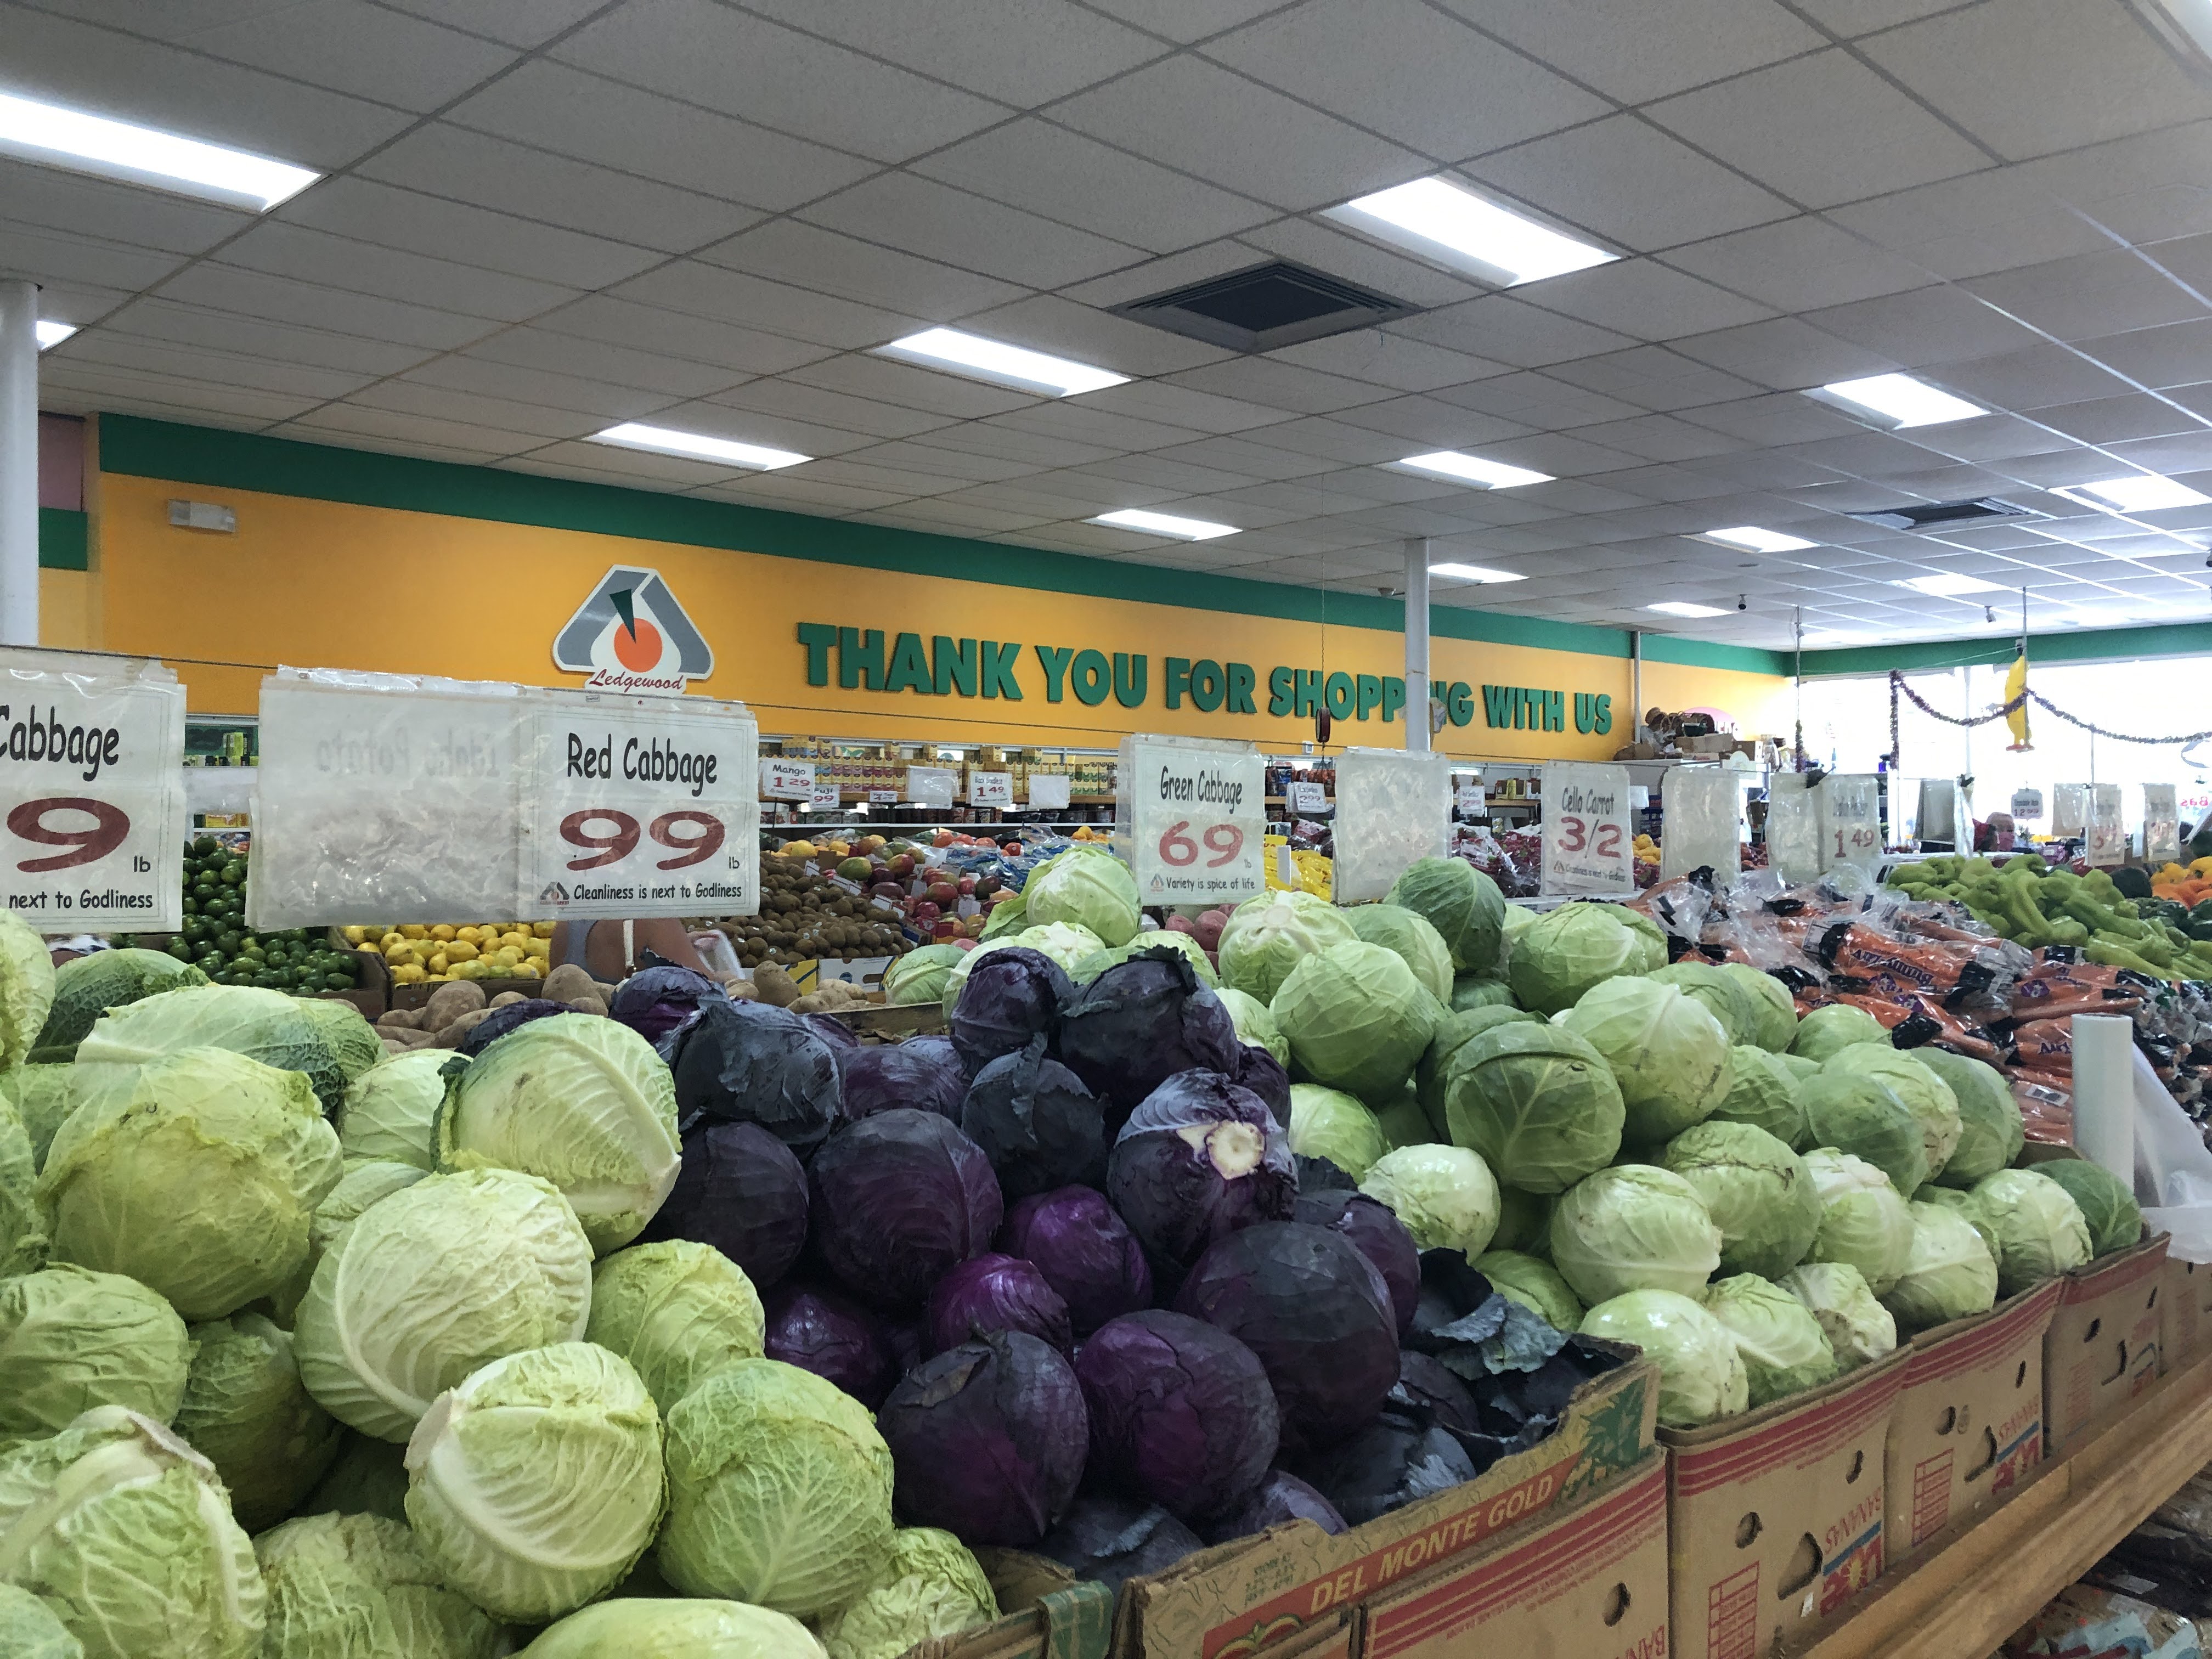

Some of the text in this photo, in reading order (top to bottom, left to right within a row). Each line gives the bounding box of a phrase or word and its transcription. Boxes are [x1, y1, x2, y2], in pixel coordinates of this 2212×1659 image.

[589, 668, 684, 693] Ledgewood
[797, 622, 1612, 735] THANK YOU FOR SHOPPG WITH US
[567, 732, 718, 797] Red Cabbage
[772, 764, 806, 777] Mango
[1160, 765, 1243, 815] Green Cabbage
[1561, 786, 1615, 816] Cello Carrot
[7, 797, 131, 873] 9
[560, 809, 725, 871] 99
[1159, 821, 1244, 868] 69
[1558, 816, 1623, 859] 3/2
[133, 855, 151, 873] lb
[729, 856, 740, 870] lb
[1244, 859, 1252, 868] lb
[9, 889, 153, 909] next to Godliness
[574, 882, 742, 900] Cleanliness is next to Godliness
[1166, 877, 1255, 893] Variety is spice of life
[1309, 1565, 1368, 1615] DEL
[1378, 1511, 1481, 1583] MONTE
[1487, 1475, 1554, 1527] GOLD
